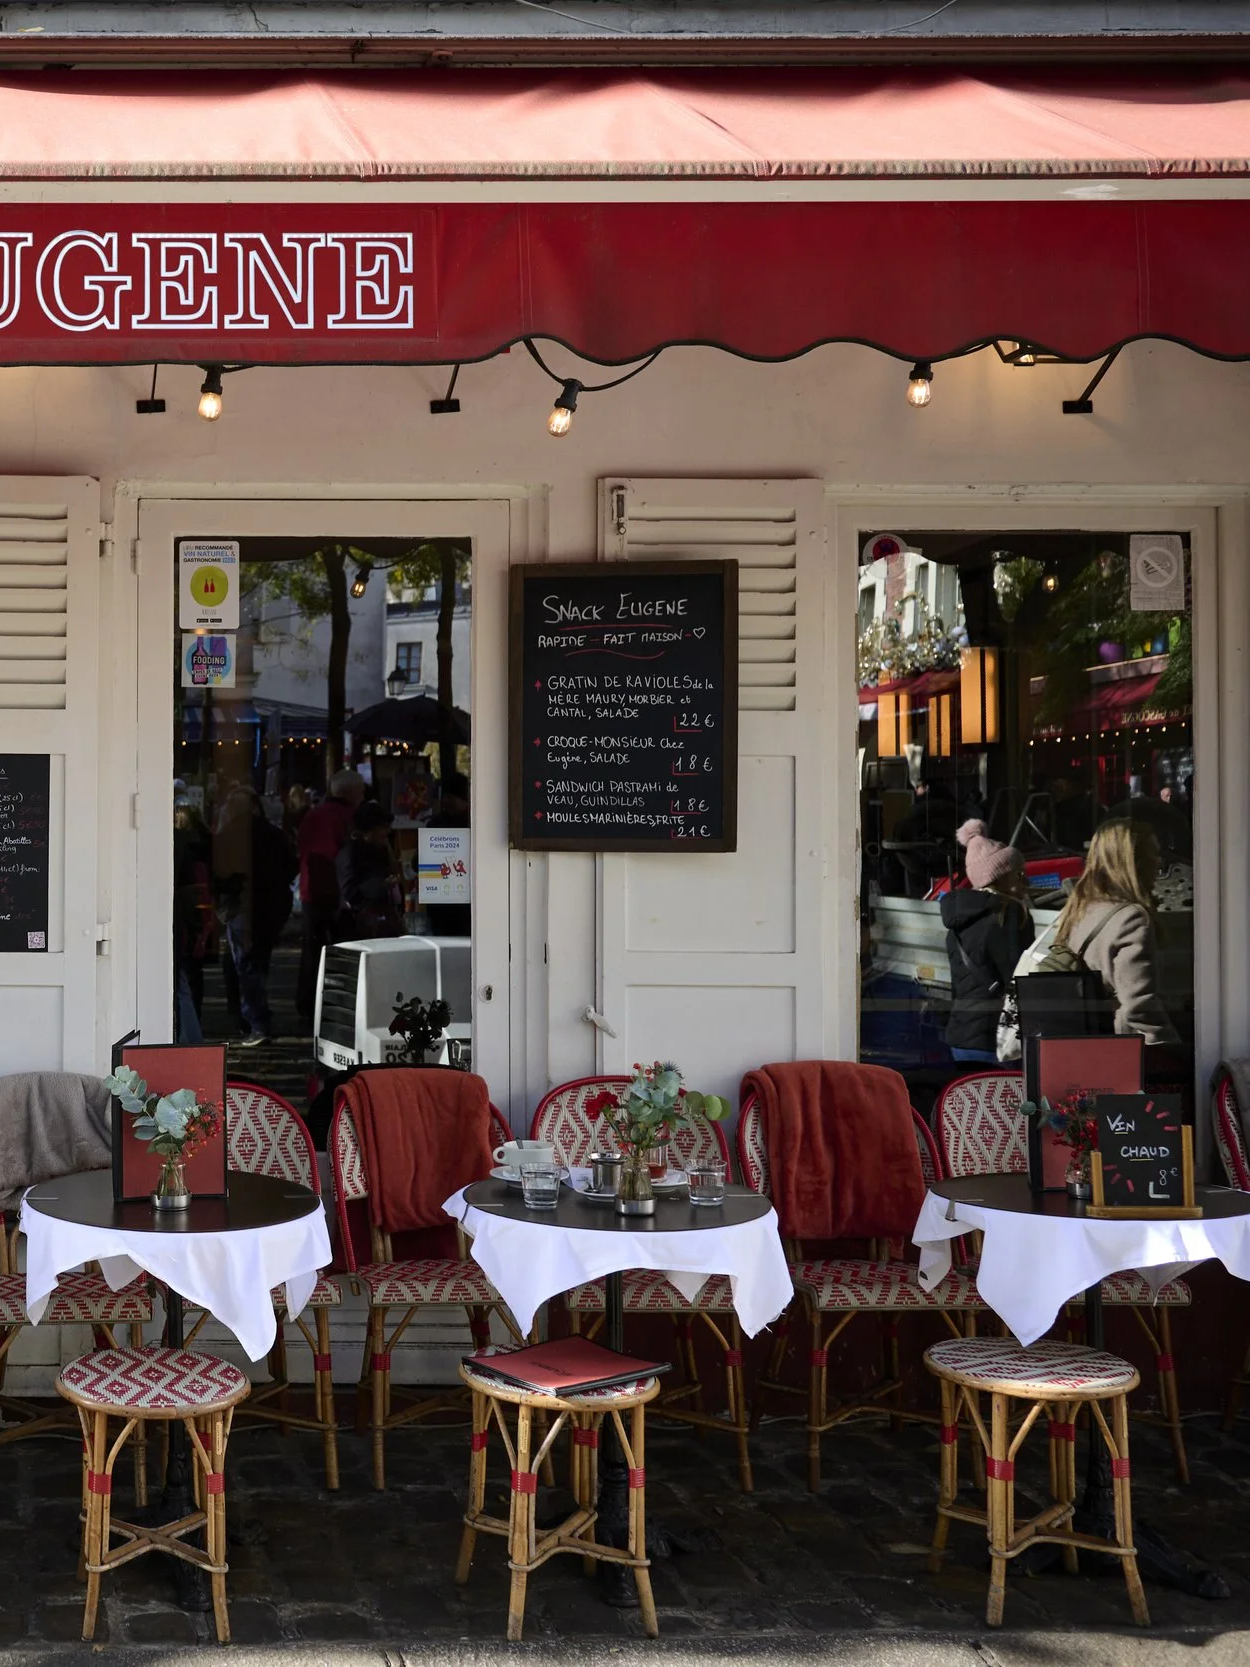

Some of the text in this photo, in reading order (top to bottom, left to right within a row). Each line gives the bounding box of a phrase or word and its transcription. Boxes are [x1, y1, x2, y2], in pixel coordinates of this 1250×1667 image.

[538, 629, 683, 648] RAPIDE FAIT MAISON
[193, 656, 225, 665] FOODING
[604, 676, 621, 688] DE
[680, 696, 691, 704] et
[595, 707, 639, 719] SALADE
[589, 751, 631, 765] SALADE
[545, 779, 604, 793] SANDWICH
[666, 781, 679, 792] de
[1106, 1113, 1135, 1132] VIN
[1120, 1145, 1170, 1158] CHAUD
